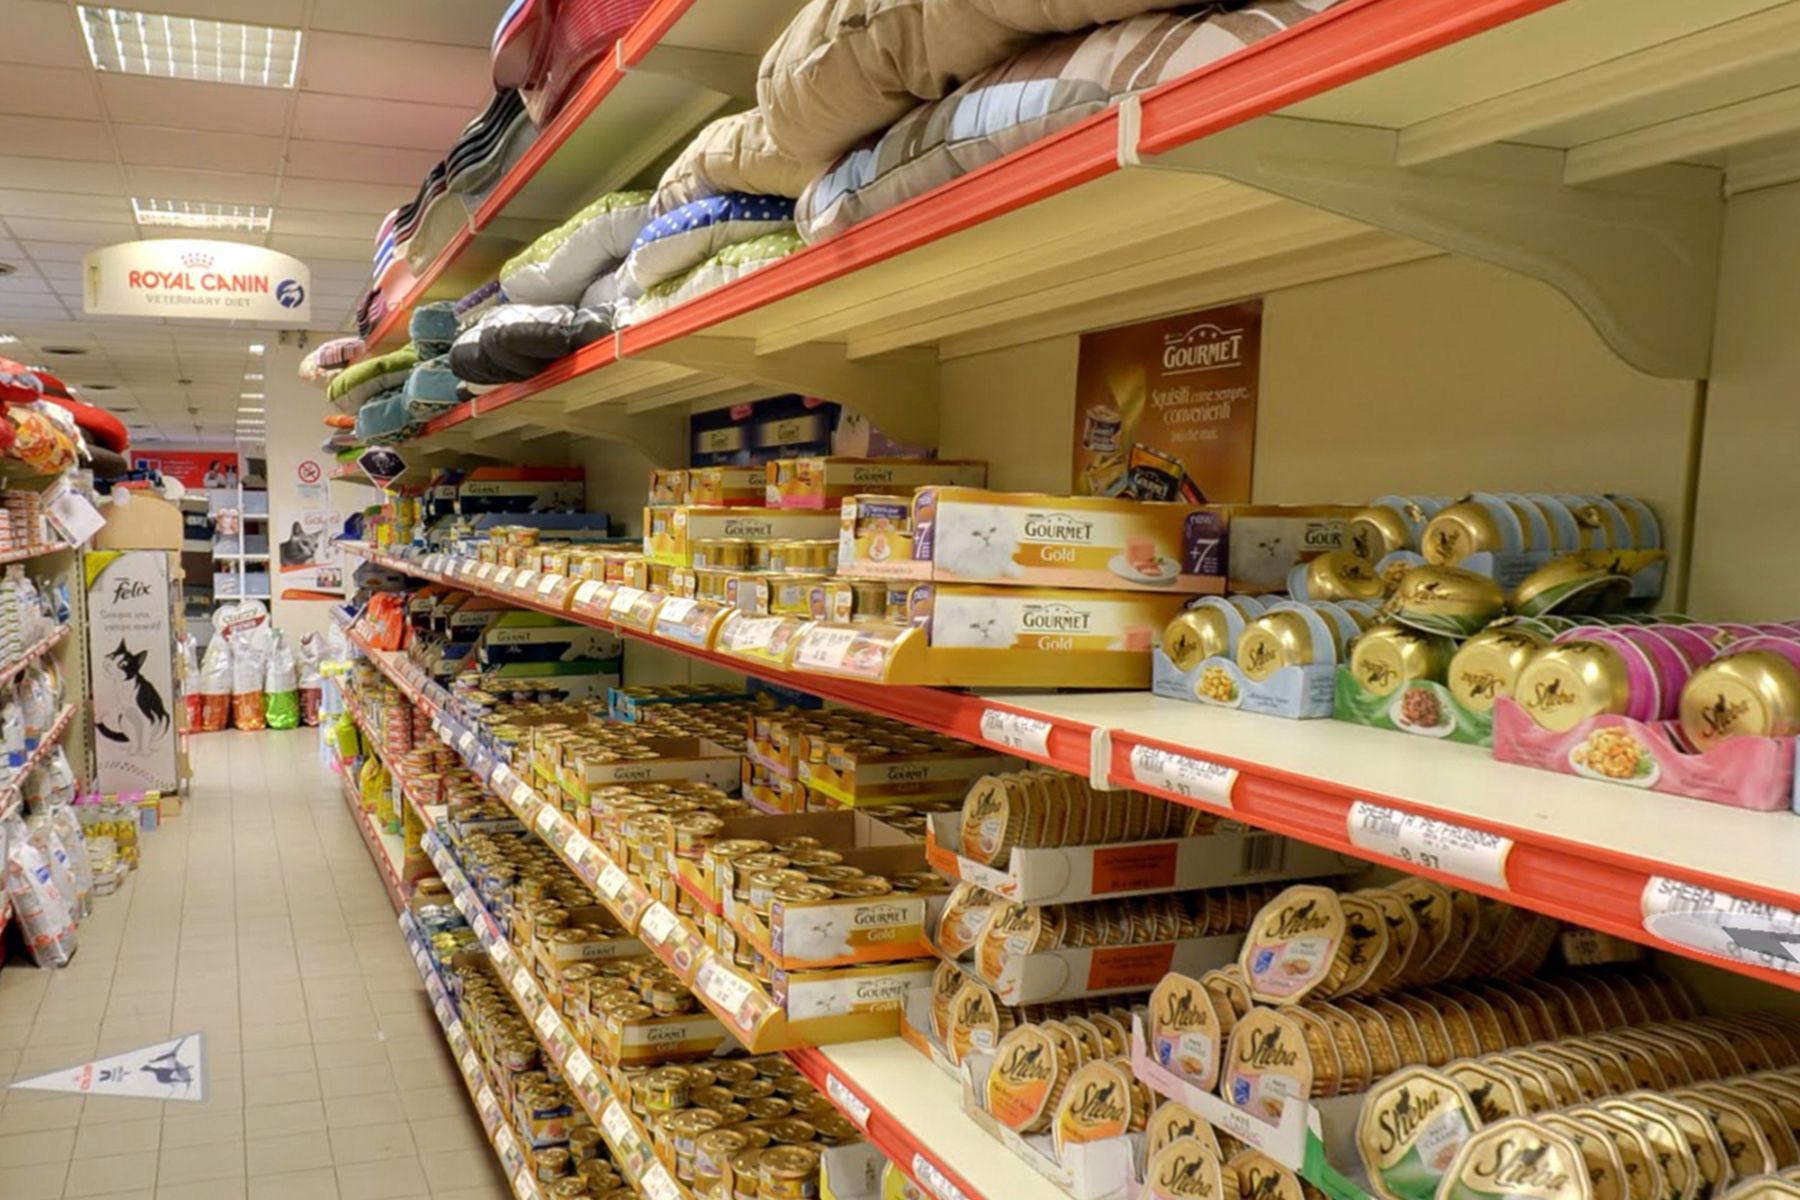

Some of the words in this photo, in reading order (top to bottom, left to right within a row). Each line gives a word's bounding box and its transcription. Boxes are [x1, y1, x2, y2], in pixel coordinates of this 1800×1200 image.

[129, 270, 195, 291] ROYAL
[200, 273, 268, 293] CANIN
[145, 294, 220, 306] VETERINARY
[225, 297, 250, 307] DIET
[1163, 335, 1242, 368] GOURMET
[725, 523, 773, 537] GOURMET
[1024, 520, 1093, 541] GOURMET
[1040, 545, 1076, 563] Gold
[1022, 611, 1091, 631] GOURMET
[1037, 635, 1074, 650] Gold
[1527, 680, 1577, 712] Sheba
[1702, 699, 1750, 738] Sheba
[1657, 877, 1716, 906] SHEBA
[854, 908, 908, 925] GOURMET
[1265, 903, 1331, 940] Sheba
[867, 928, 896, 941] Gold
[1160, 992, 1207, 1031] Sheba
[1000, 1044, 1051, 1082] Sheba
[1239, 1027, 1298, 1070] Sheba
[1070, 1082, 1125, 1124] Sheba
[1378, 1089, 1441, 1155] Sheba
[1160, 1155, 1213, 1198] Sheba
[1474, 1138, 1570, 1190] Sheba
